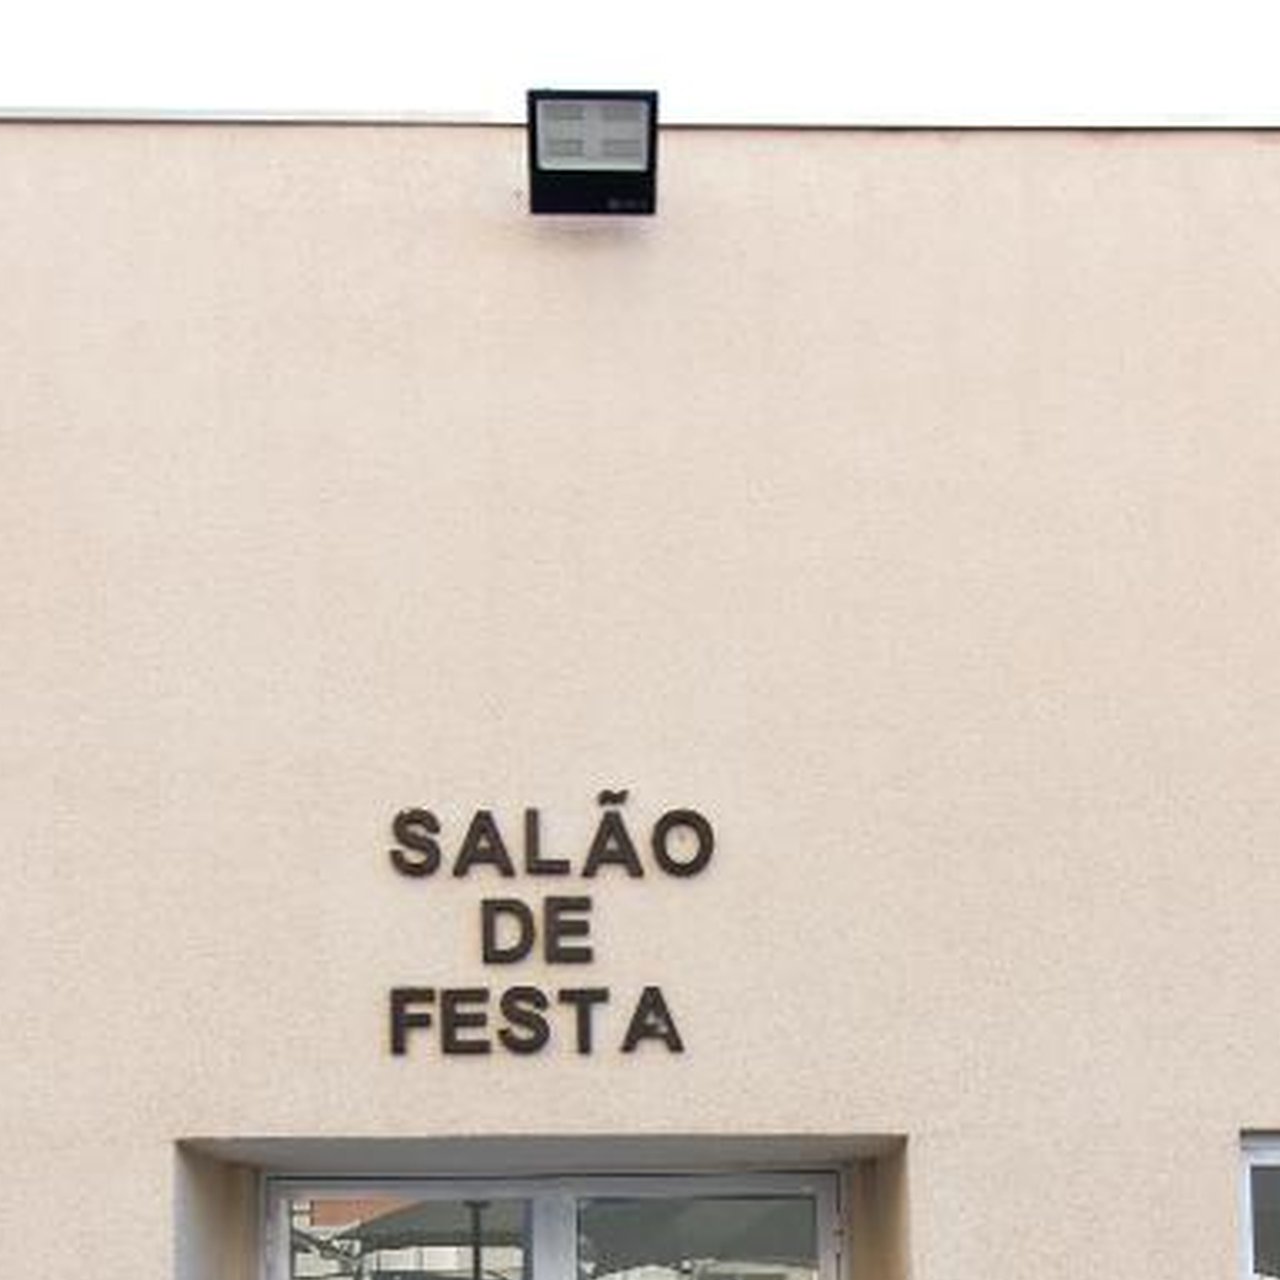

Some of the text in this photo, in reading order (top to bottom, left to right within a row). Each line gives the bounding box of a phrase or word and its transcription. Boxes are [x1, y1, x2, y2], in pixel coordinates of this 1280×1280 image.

[389, 789, 715, 879] SALÃO
[480, 895, 594, 965] DE
[389, 985, 685, 1057] FESTA
